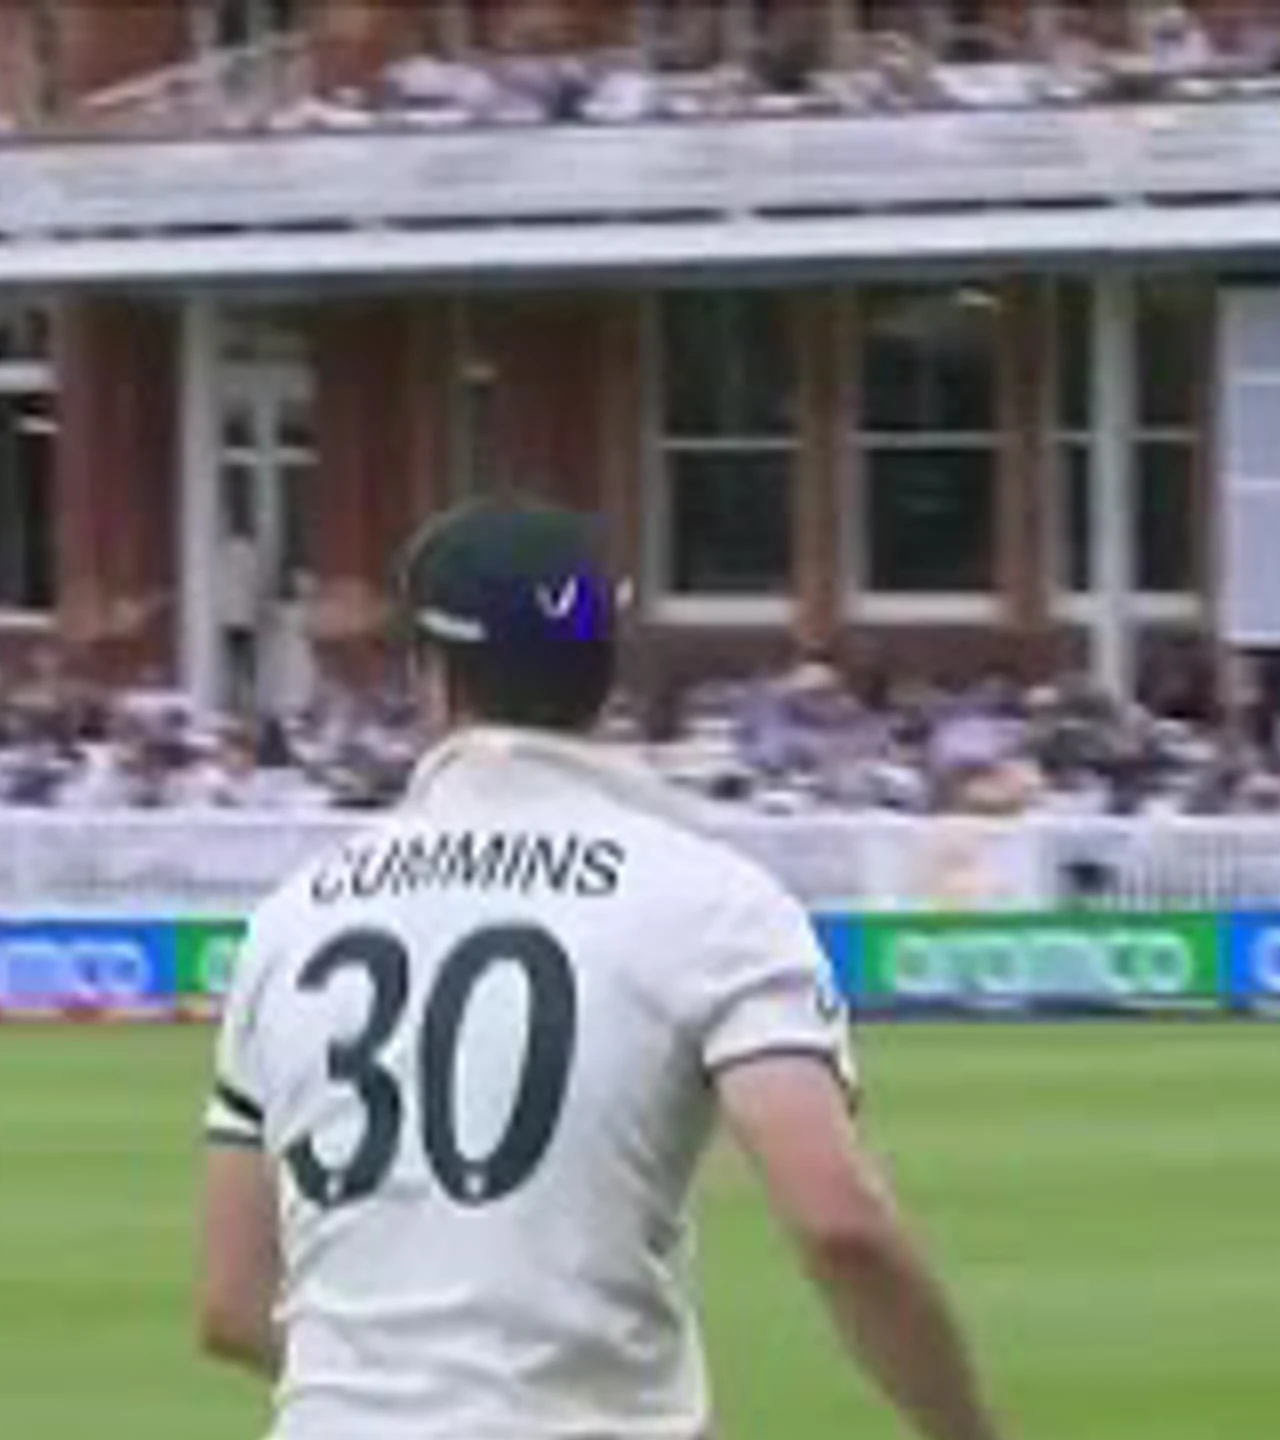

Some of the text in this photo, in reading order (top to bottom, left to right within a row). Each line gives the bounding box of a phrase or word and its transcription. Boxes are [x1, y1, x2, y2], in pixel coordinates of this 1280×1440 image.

[311, 830, 625, 905] CUMMINS
[884, 931, 1190, 995] aramco
[285, 922, 578, 1207] 30
